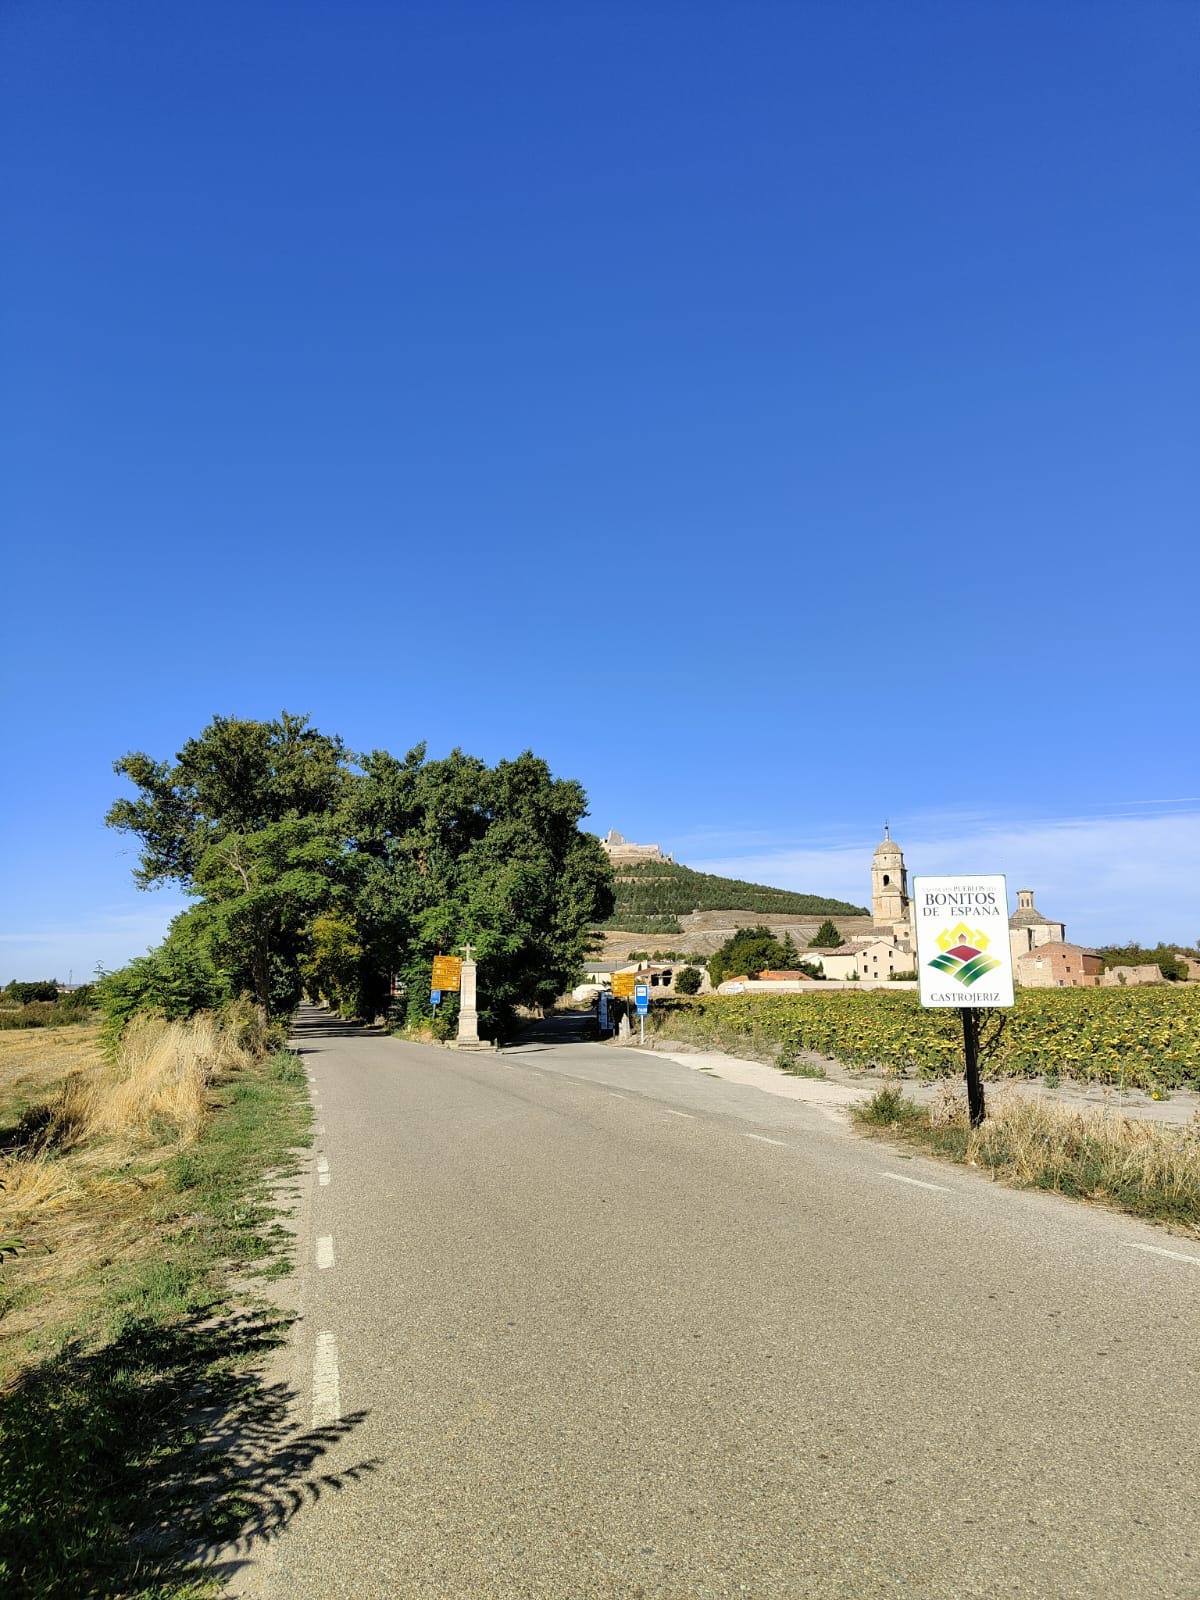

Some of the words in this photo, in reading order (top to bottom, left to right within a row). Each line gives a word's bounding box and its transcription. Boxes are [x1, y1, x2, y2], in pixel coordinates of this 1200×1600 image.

[925, 892, 996, 905] BONITOS
[923, 907, 939, 916] DE
[930, 992, 1000, 1003] CASTROJERIZ
